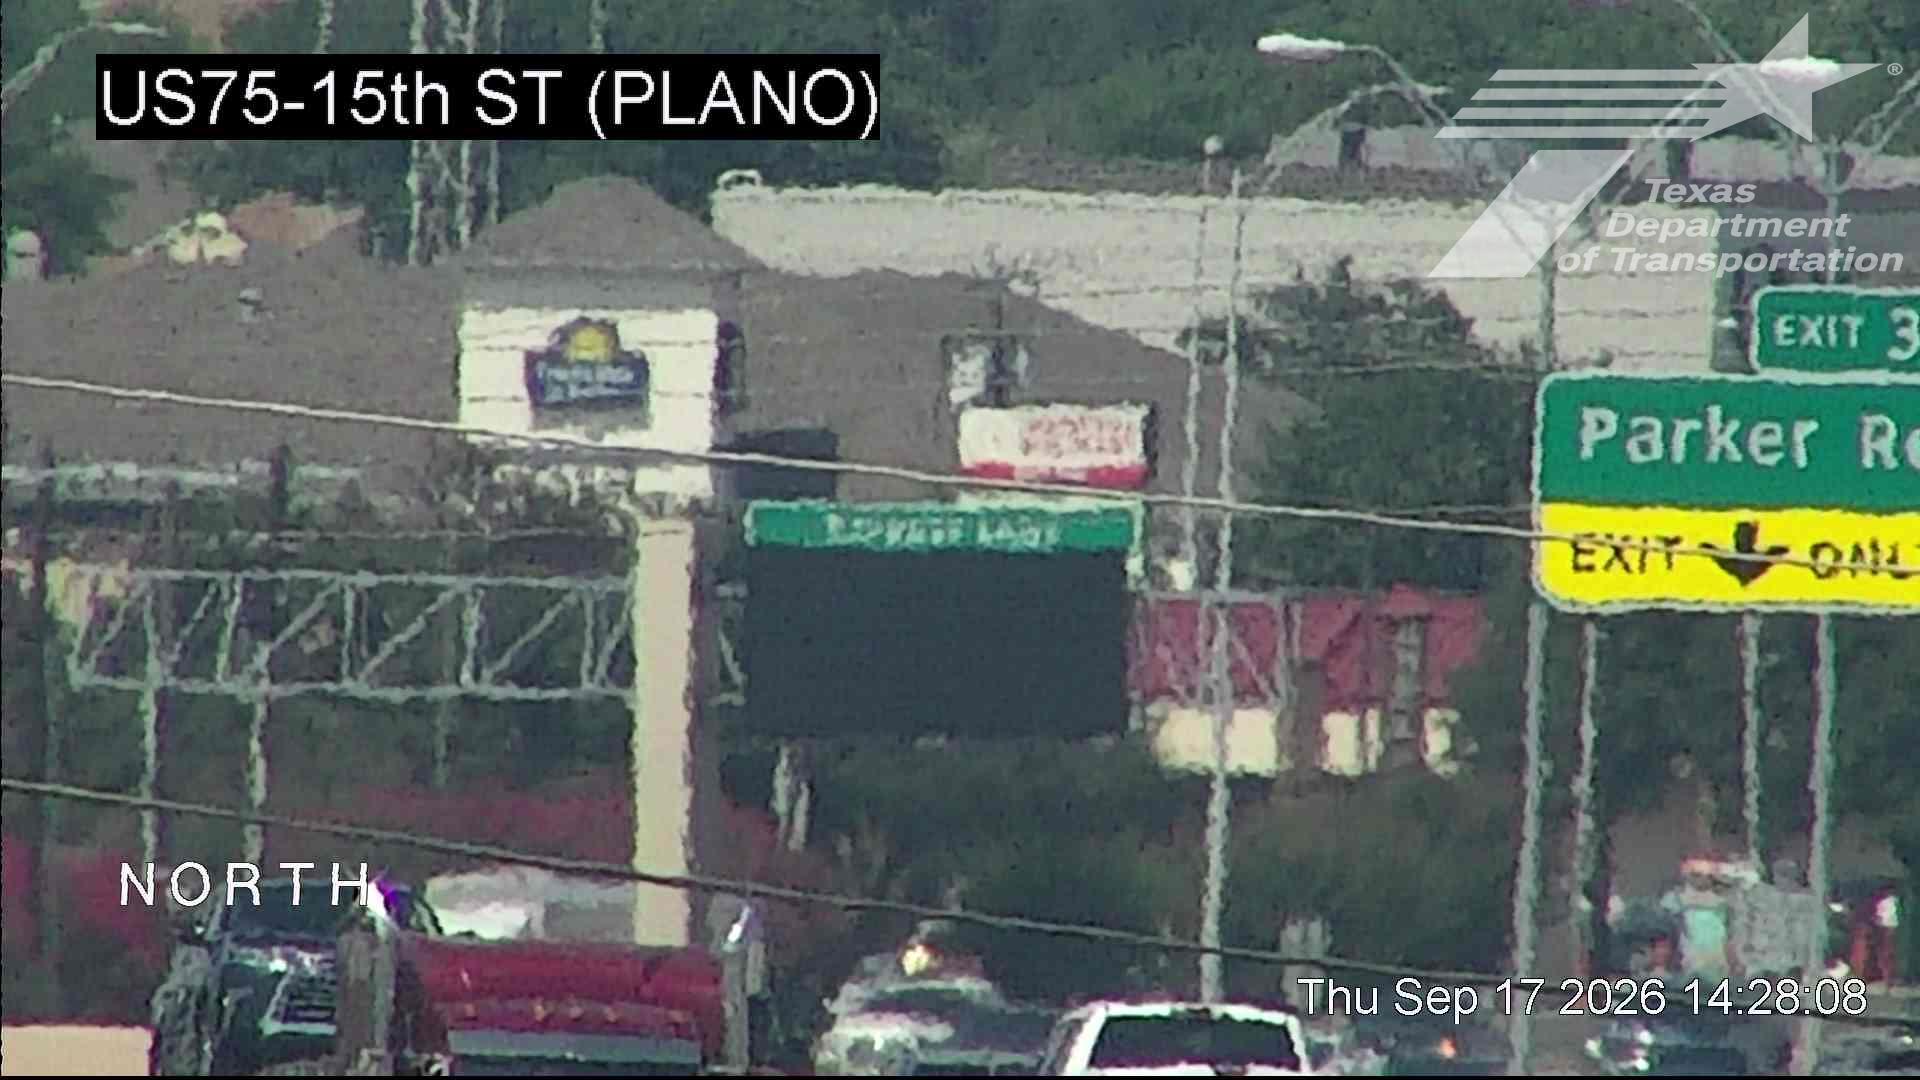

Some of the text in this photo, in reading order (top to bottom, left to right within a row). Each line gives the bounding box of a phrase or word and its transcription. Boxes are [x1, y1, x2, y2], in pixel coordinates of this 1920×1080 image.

[1773, 314, 1865, 349] EXIT
[1578, 403, 1820, 469] Parker
[1570, 531, 1920, 580] EXIT ONL
